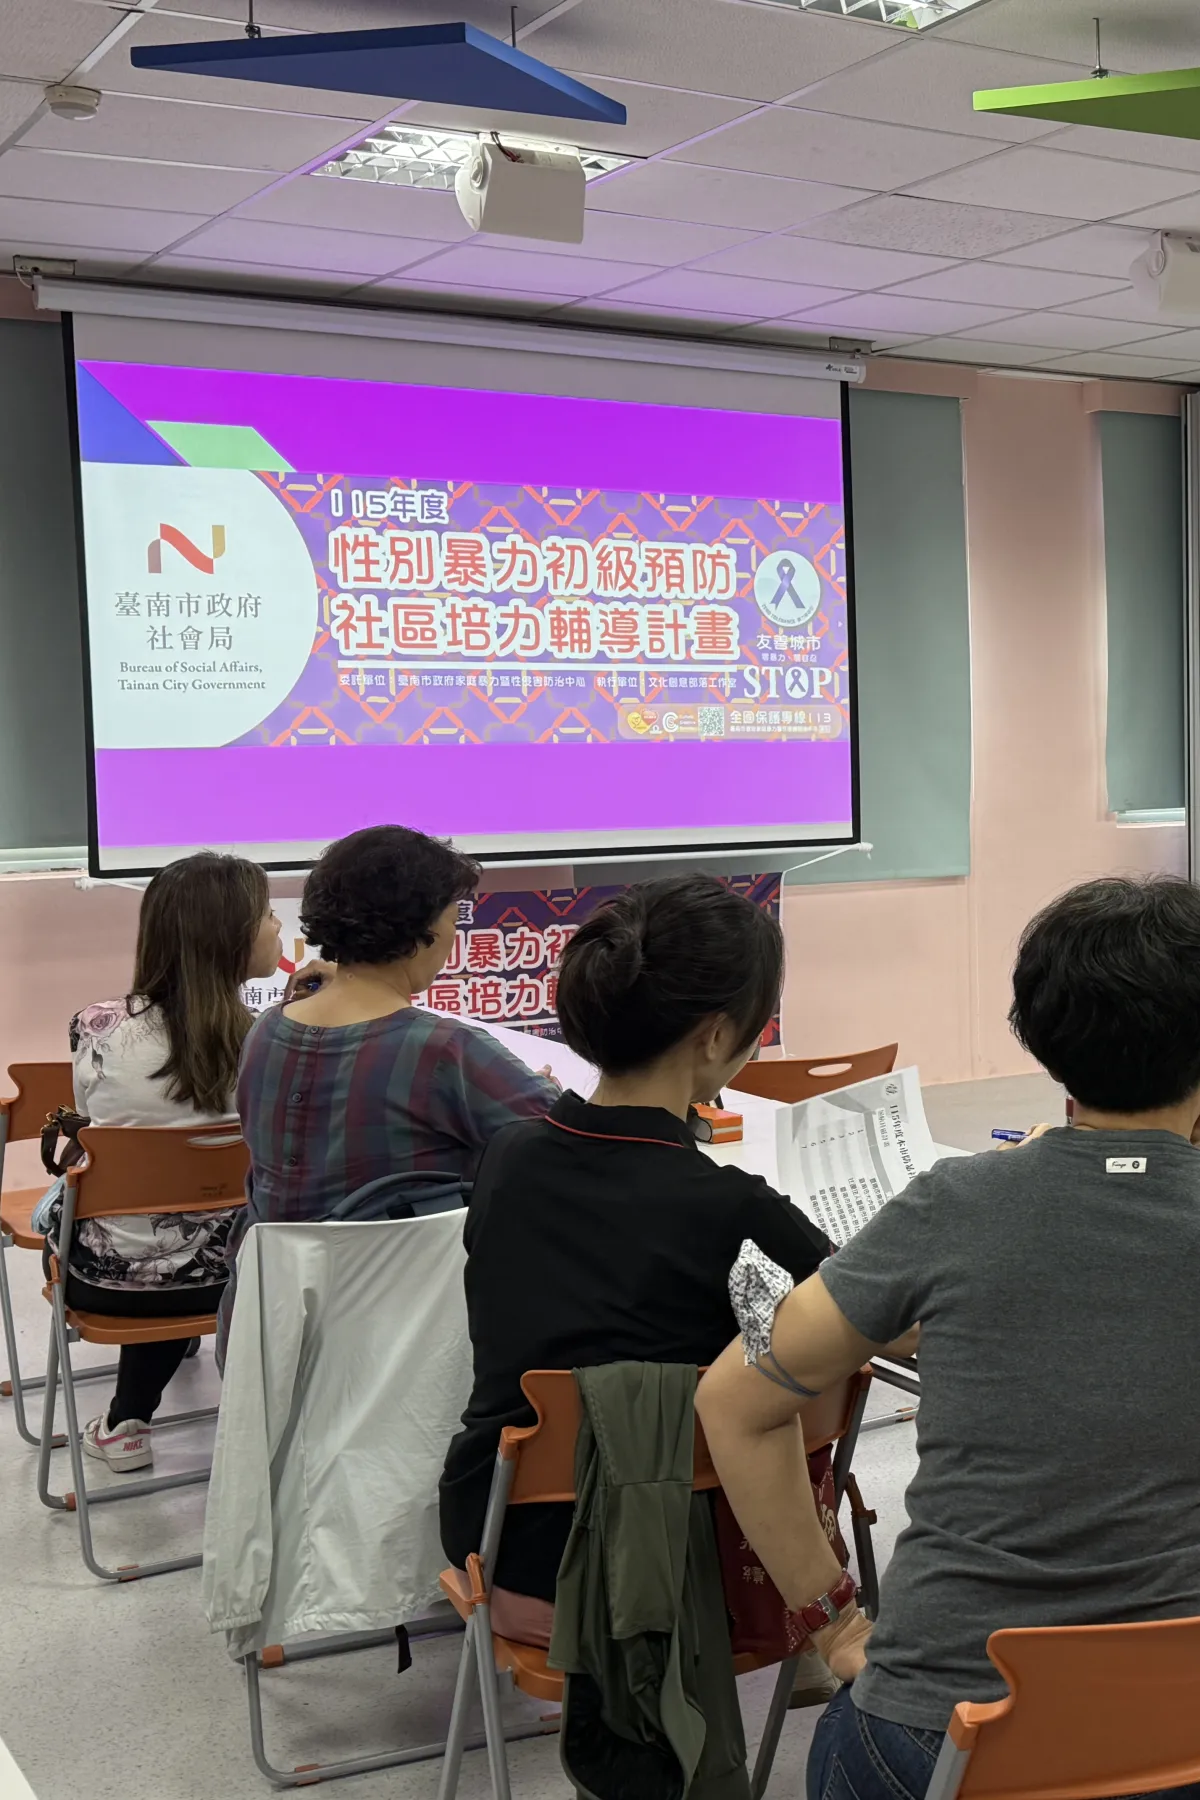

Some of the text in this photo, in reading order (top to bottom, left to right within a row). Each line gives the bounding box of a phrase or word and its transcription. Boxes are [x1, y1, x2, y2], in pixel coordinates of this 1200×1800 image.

[332, 490, 447, 523] 115年度
[332, 531, 733, 596] 性別暴力初級預防
[115, 591, 262, 618] 臺南市政府
[146, 625, 233, 651] 社會局
[334, 599, 736, 656] 社區培力輔導計畫
[757, 634, 821, 651] 友善城市
[120, 661, 263, 674] Bureau of Social Affairs,
[118, 679, 266, 693] Tainan City Government
[743, 665, 832, 699] STOP
[123, 1439, 143, 1451] NIKE
